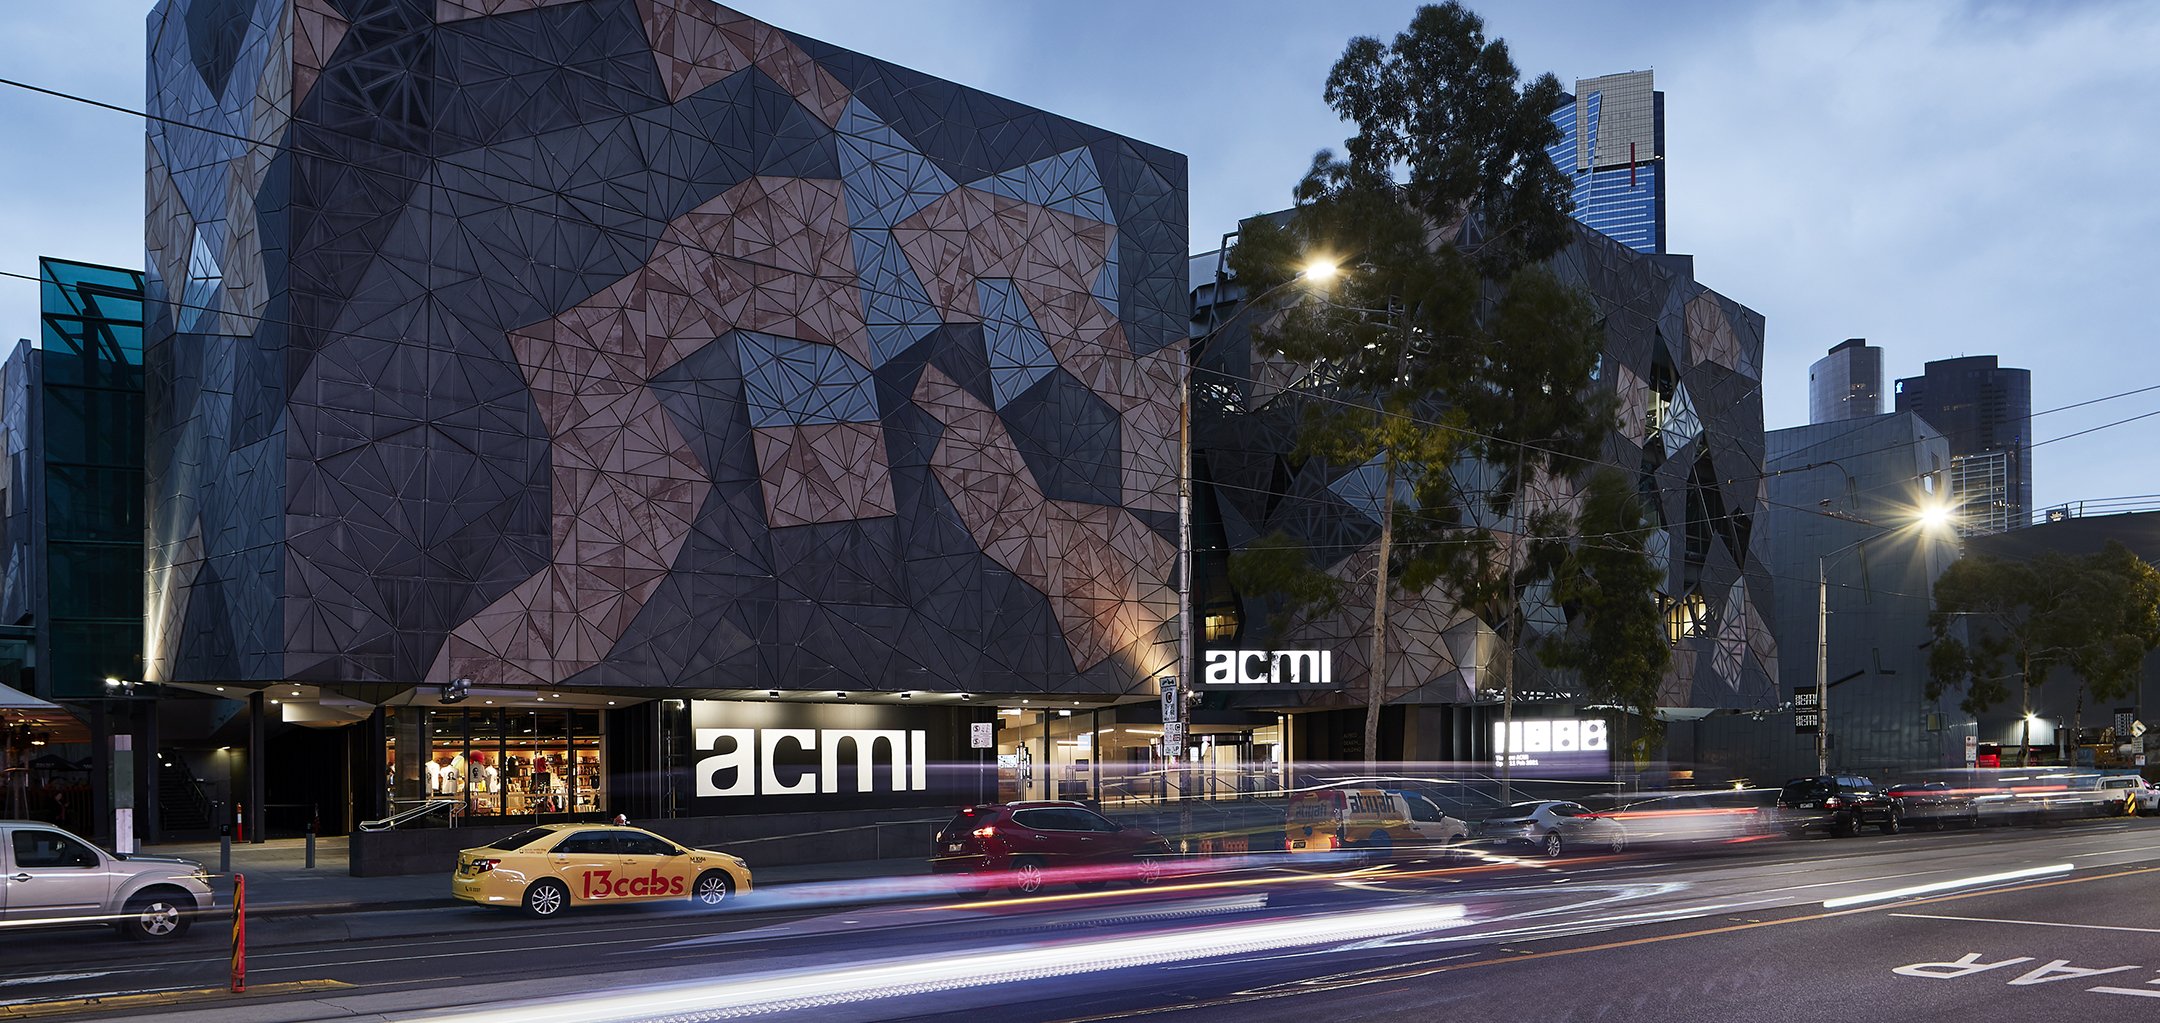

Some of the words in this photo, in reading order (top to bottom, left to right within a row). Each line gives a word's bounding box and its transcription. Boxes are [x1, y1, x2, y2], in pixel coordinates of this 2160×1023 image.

[1205, 650, 1332, 684] acmi
[695, 728, 926, 798] acmi
[582, 869, 685, 899] 13cabs
